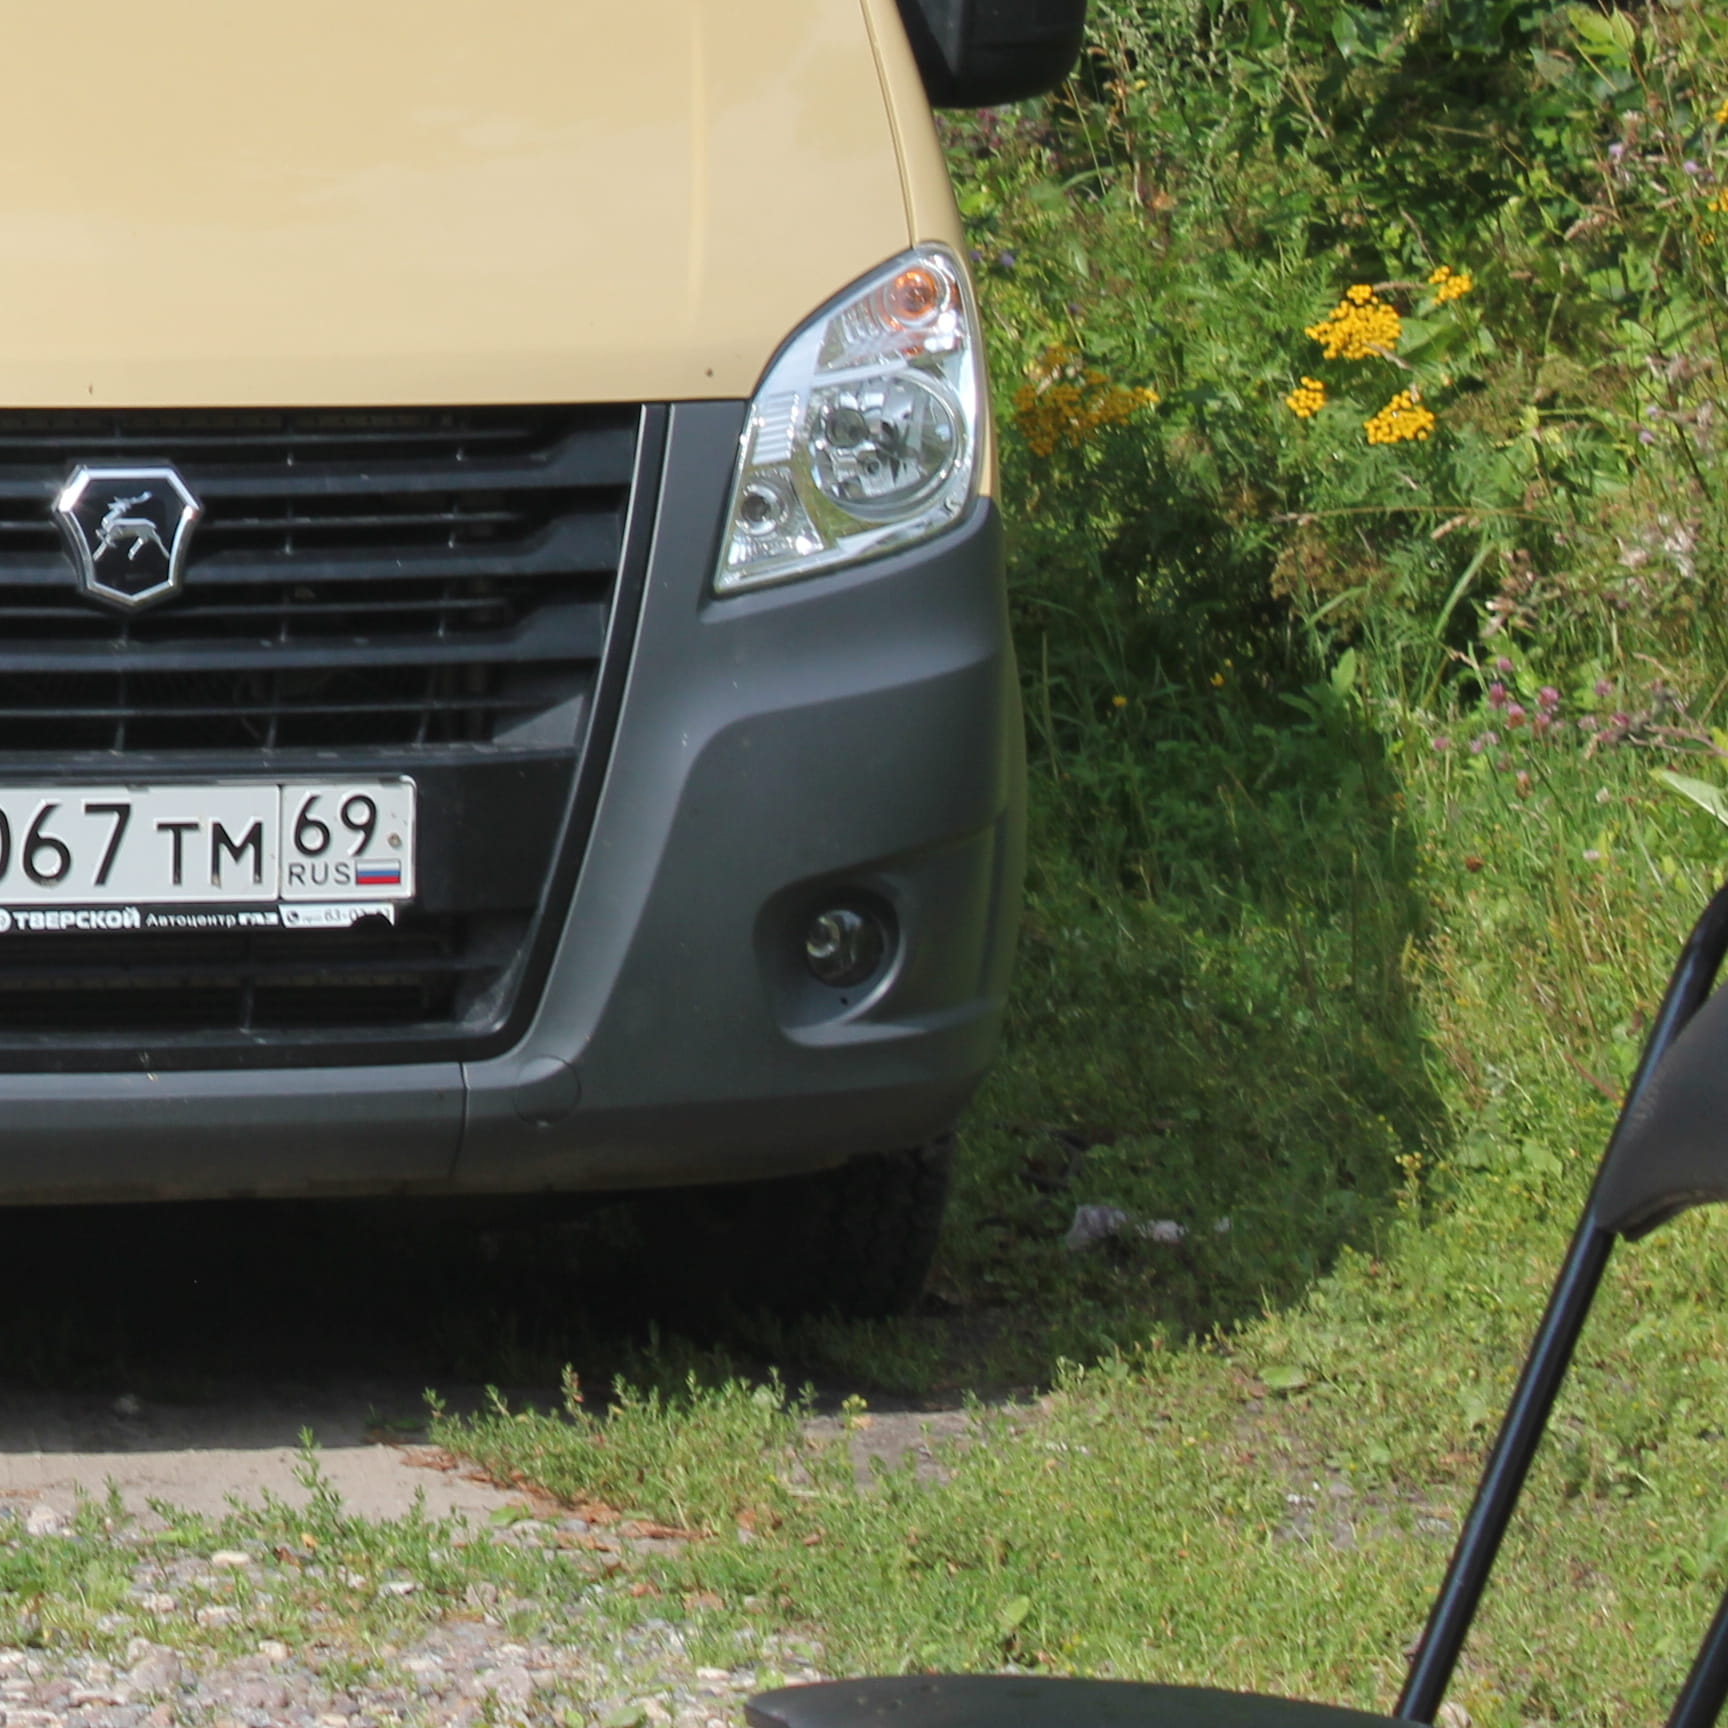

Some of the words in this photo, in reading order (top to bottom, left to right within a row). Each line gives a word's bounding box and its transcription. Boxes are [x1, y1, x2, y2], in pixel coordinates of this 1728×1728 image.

[292, 794, 377, 858] 69
[288, 862, 352, 887] RUS
[12, 906, 141, 930] ТВЕРСКОЙ
[145, 912, 236, 929] Автоцентр
